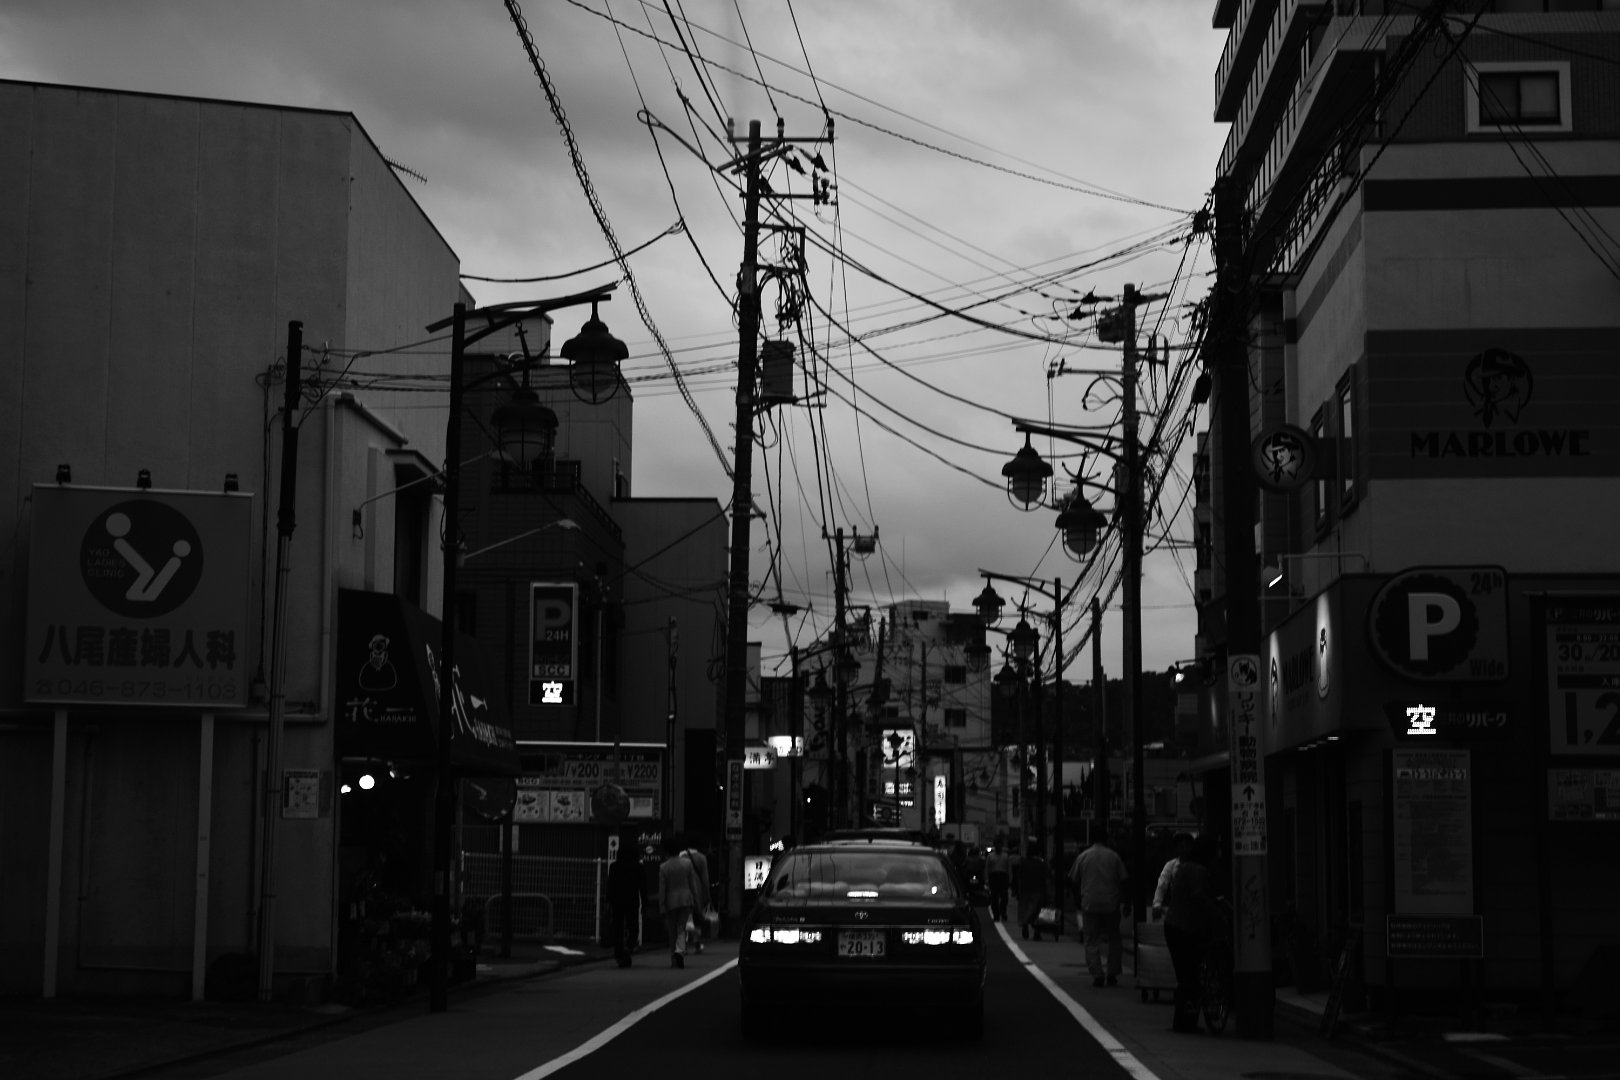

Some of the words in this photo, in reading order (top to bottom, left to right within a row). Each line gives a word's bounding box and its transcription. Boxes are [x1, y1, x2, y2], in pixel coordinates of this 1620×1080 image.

[1410, 430, 1591, 458] MARLOWE
[536, 598, 571, 641] P
[545, 630, 569, 641] 24H
[1407, 592, 1462, 662] P
[38, 623, 237, 670] 八尾産婦人科
[1470, 658, 1505, 677] Wide
[1406, 703, 1437, 736] 空
